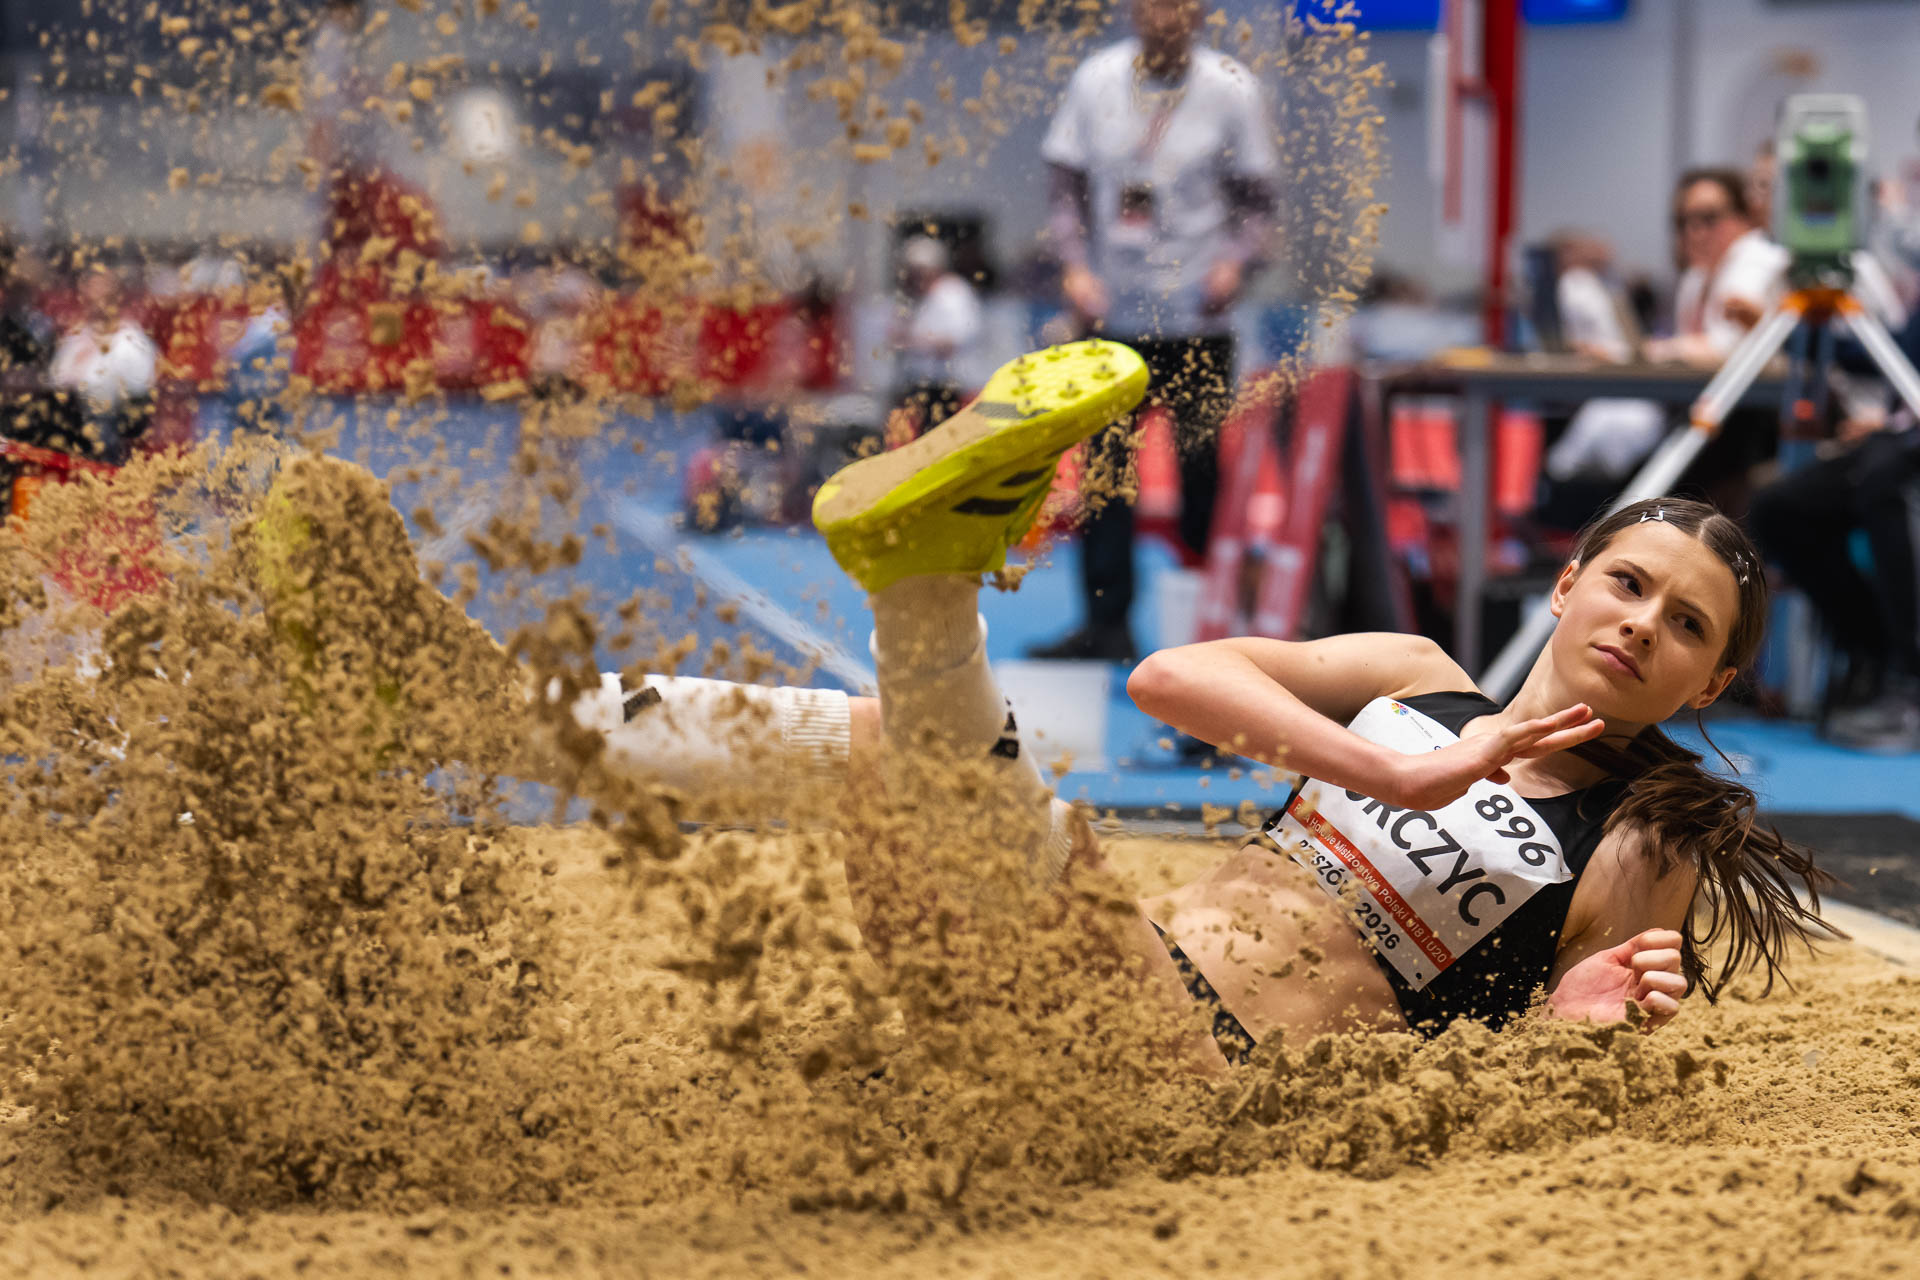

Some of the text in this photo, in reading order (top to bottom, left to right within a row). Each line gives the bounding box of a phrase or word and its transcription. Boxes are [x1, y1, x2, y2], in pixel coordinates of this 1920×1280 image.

[1475, 794, 1557, 866] 896
[1334, 840, 1381, 891] Mistrzostwa
[1378, 888, 1410, 920] Polski
[1426, 940, 1447, 963] U20
[1355, 902, 1400, 950] 2026
